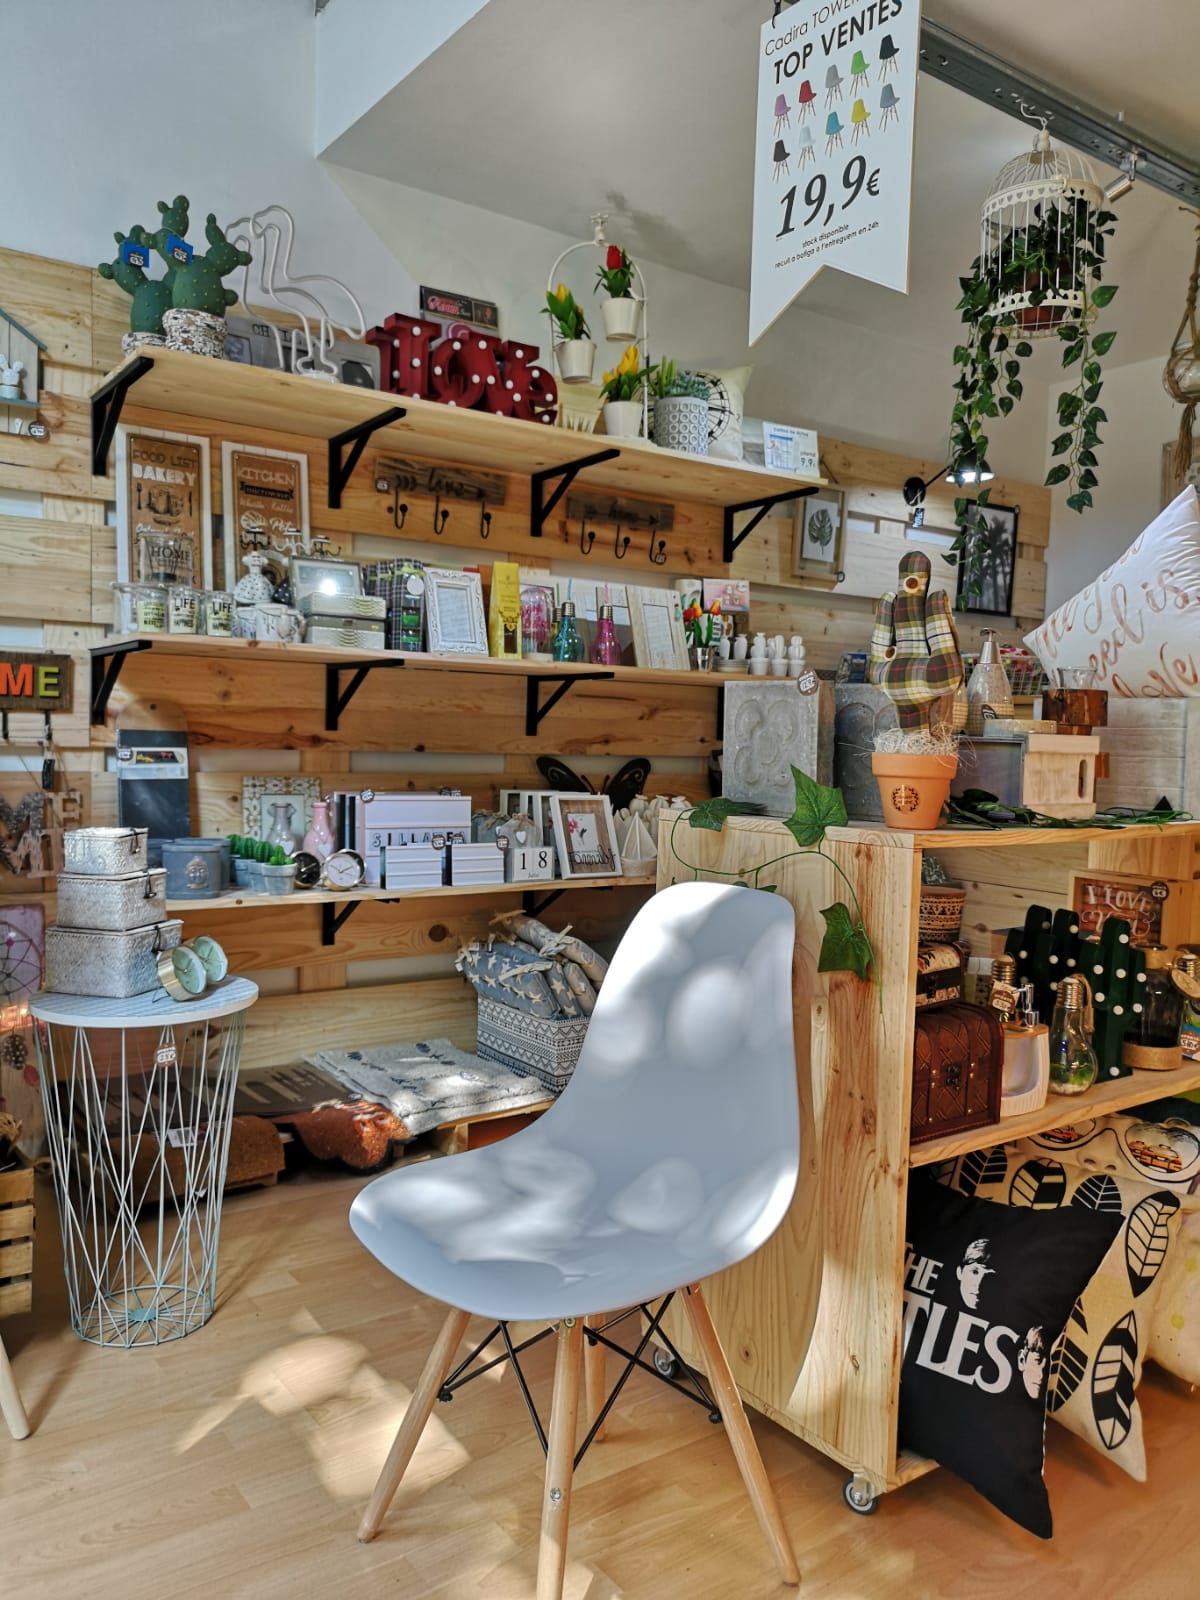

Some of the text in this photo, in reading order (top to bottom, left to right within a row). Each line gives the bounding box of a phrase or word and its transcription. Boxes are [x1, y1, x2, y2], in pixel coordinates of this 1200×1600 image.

[764, 0, 859, 56] Cadira TOWE
[774, 0, 903, 85] TOP VENTES
[775, 154, 881, 239] 19,9€
[819, 223, 849, 241] disponible
[133, 449, 166, 464] FOOD
[132, 463, 197, 487] BAKERY
[151, 545, 191, 561] HOME
[174, 597, 195, 611] LIFE
[0, 662, 60, 698] ME
[1086, 885, 1155, 916] I LOVE
[1081, 911, 1157, 938] YU
